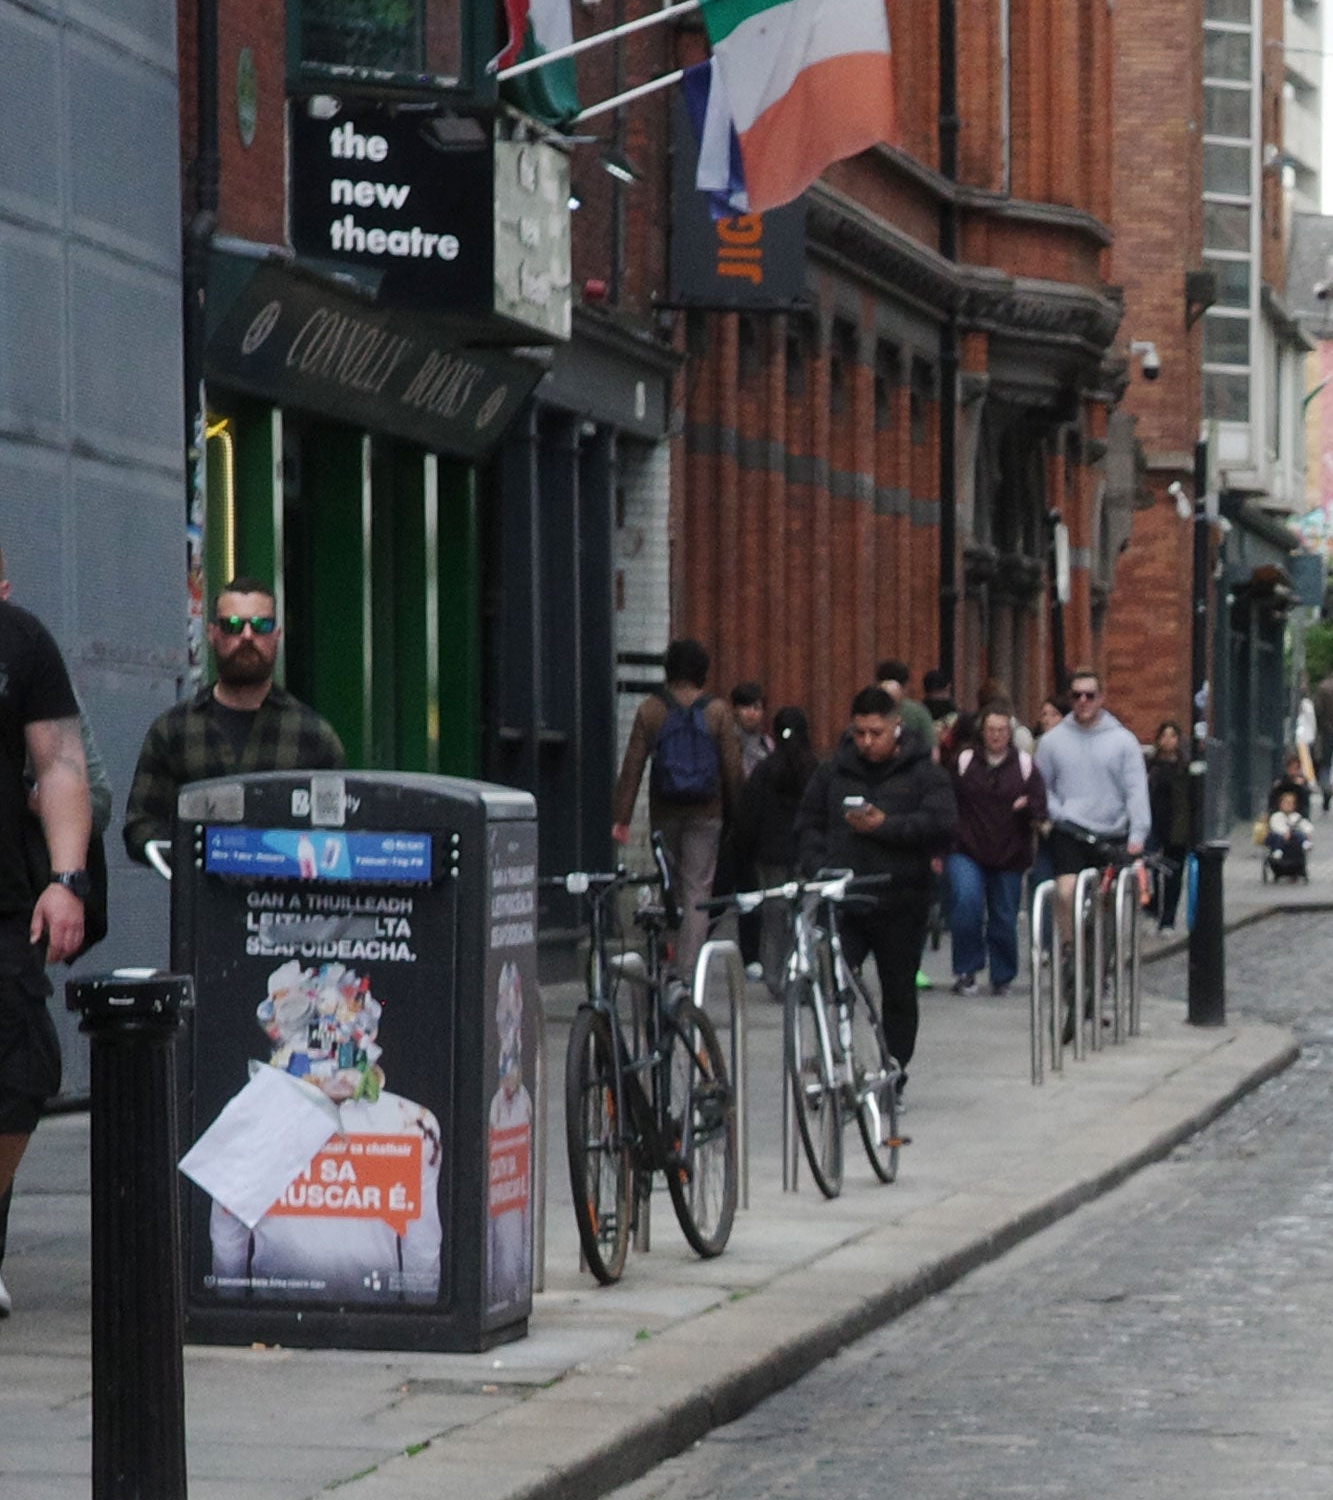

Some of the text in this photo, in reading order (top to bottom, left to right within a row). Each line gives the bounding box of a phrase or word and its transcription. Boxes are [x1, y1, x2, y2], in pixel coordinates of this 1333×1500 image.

[330, 121, 389, 162] the
[330, 178, 411, 210] new
[329, 214, 460, 261] theatre
[286, 307, 485, 419] CONNOLLY BOOKS
[320, 1158, 357, 1183] SA
